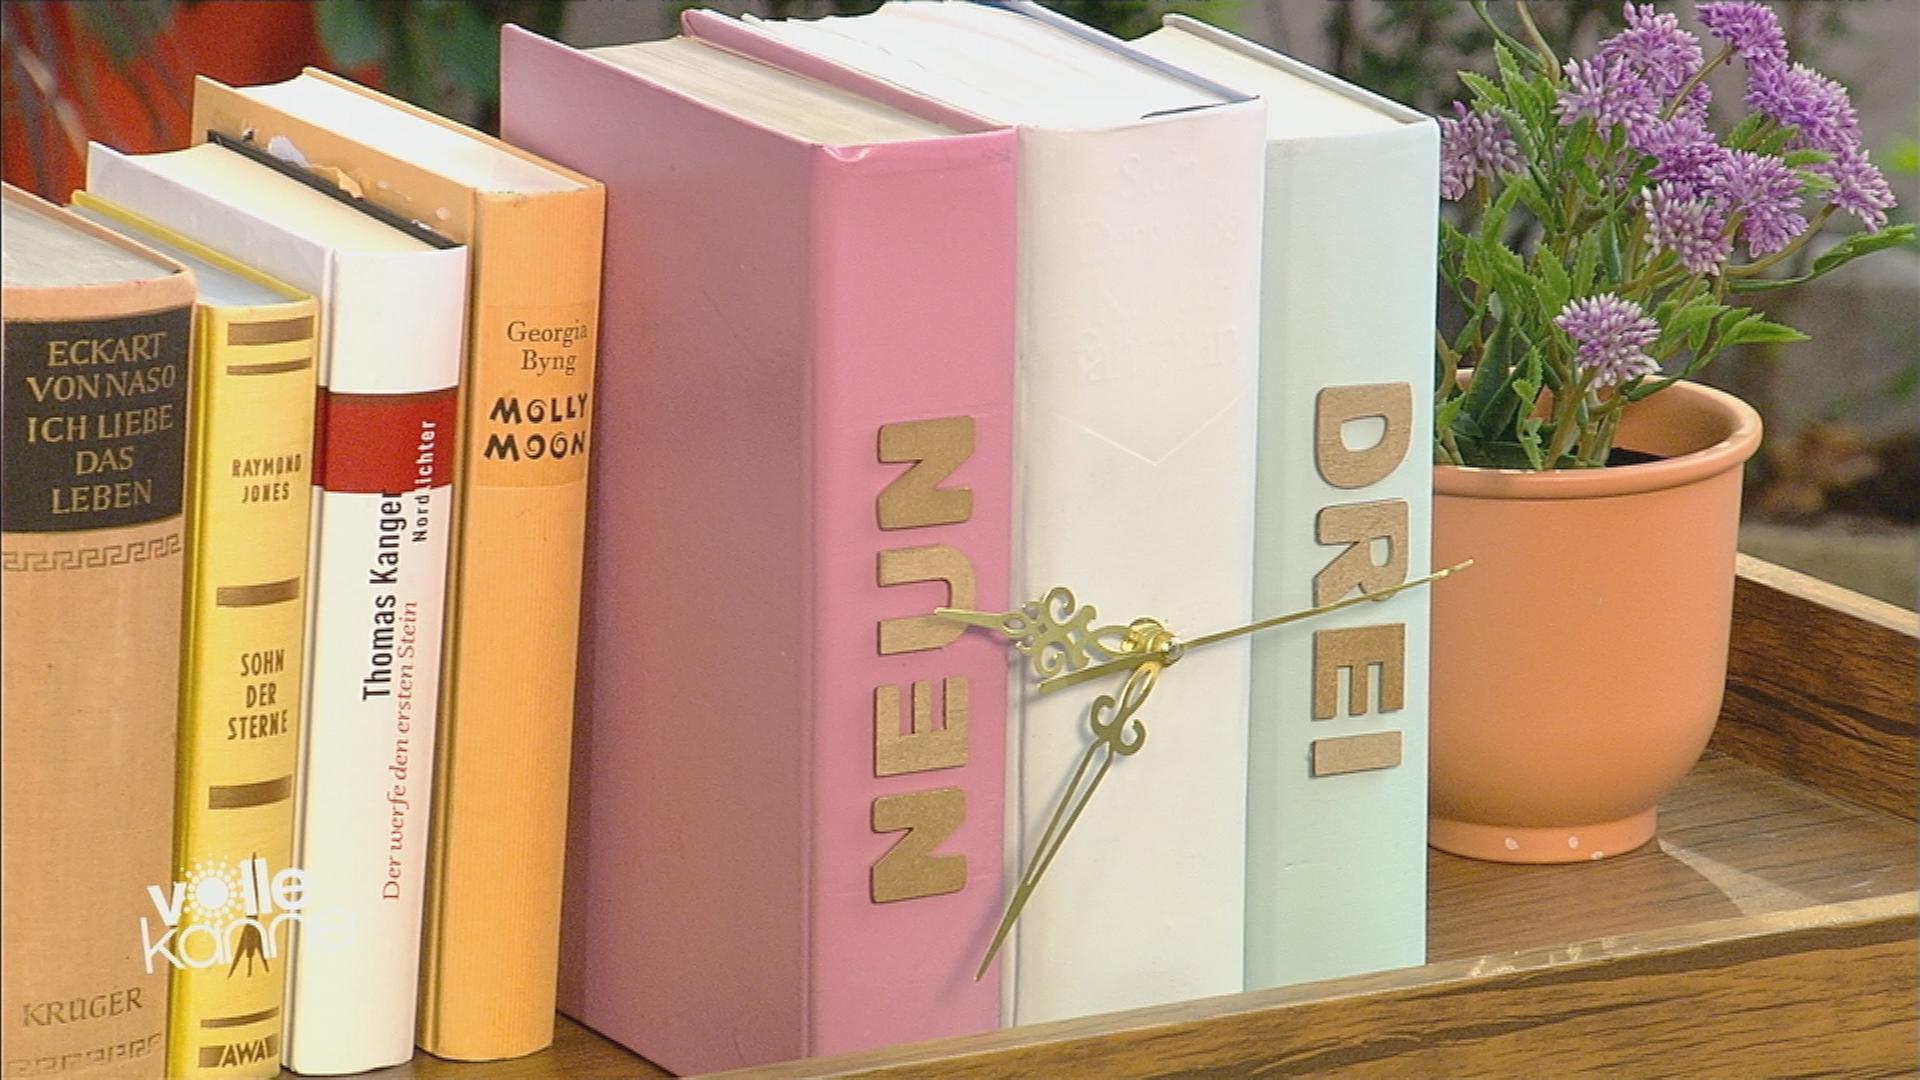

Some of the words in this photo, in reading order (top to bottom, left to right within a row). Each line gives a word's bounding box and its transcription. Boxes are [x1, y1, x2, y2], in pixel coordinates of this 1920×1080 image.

[48, 331, 166, 367] ECKART
[507, 319, 588, 347] Georgia
[521, 349, 577, 376] Byng
[26, 375, 100, 402] VON
[105, 364, 176, 399] NASO
[27, 415, 87, 442] ICH
[98, 404, 174, 440] LIEBE
[489, 393, 588, 424] MOLLY
[75, 446, 134, 475] DAS
[483, 430, 586, 462] MOON
[231, 453, 302, 477] RAYMOND
[51, 480, 153, 514] LEBEN
[241, 482, 290, 503] JONES
[1311, 381, 1414, 779] DREI
[362, 594, 397, 701] Thomas
[396, 601, 418, 659] Stein
[240, 649, 285, 676] SOHN
[870, 415, 976, 904] NEUN
[246, 681, 277, 708] DER
[397, 665, 414, 735] ersten
[227, 710, 288, 740] STERNE
[388, 738, 409, 781] den
[386, 785, 410, 851] werfe
[382, 856, 401, 901] Der
[23, 986, 143, 1027] KRÜGER
[221, 1042, 268, 1068] AWA
